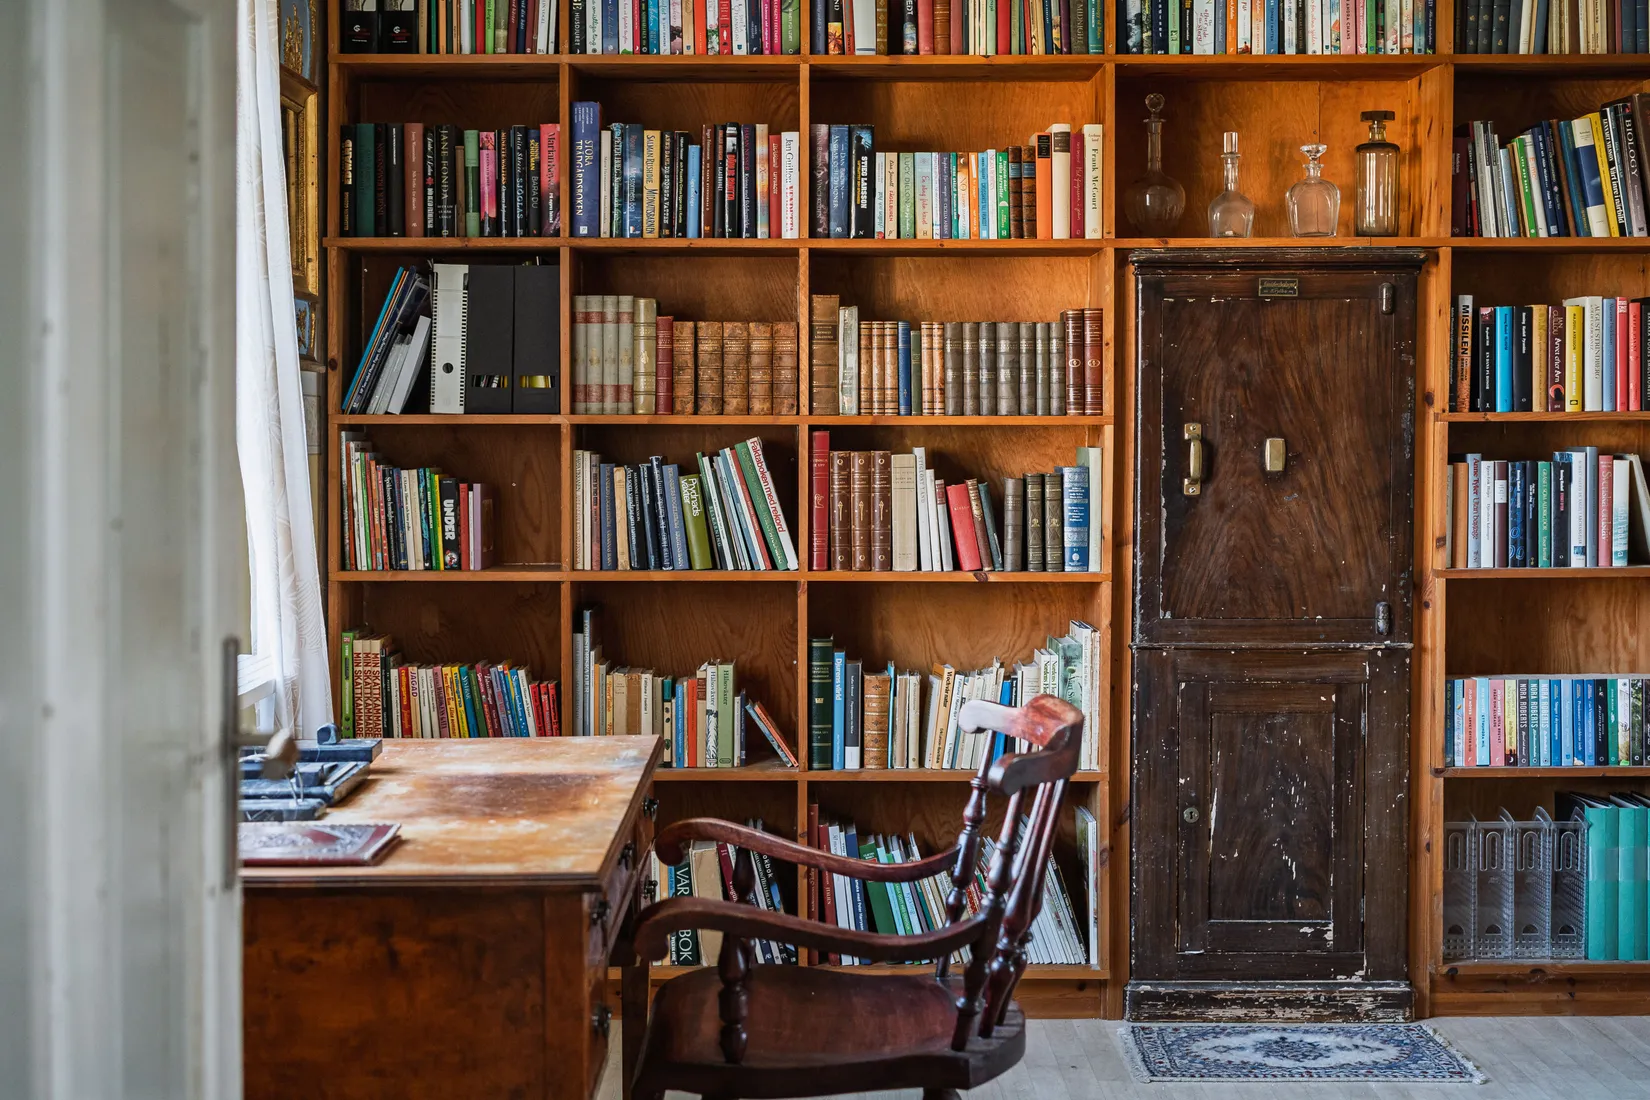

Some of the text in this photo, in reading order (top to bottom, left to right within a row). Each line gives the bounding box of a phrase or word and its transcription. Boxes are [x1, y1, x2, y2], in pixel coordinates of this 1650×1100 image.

[439, 130, 448, 156] JANE
[547, 132, 556, 162] Marian
[585, 140, 593, 166] STORA
[646, 135, 655, 158] SALMAN
[785, 138, 793, 151] Jan
[1625, 119, 1639, 177] BIOLOGY
[575, 140, 584, 216] TRÄDGÅRDSBOKEN
[785, 152, 794, 183] Guillou
[531, 197, 538, 208] DU
[1461, 305, 1469, 355] MISSILEN
[682, 478, 691, 504] växter
[689, 478, 700, 517] Prydnads
[750, 441, 785, 532] Faktaboken med rekord
[1472, 478, 1480, 495] Tyler
[1601, 471, 1612, 540] Svenska ordstäv
[443, 498, 455, 540] UNDER
[354, 653, 363, 738] MIN SKATTKAMMARE
[363, 652, 372, 738] MIN SKATTKAMMARE
[372, 653, 381, 738] MIN SKATTKAMMARE
[410, 671, 418, 698] JAGAD
[676, 867, 692, 960] VÅR BOK
